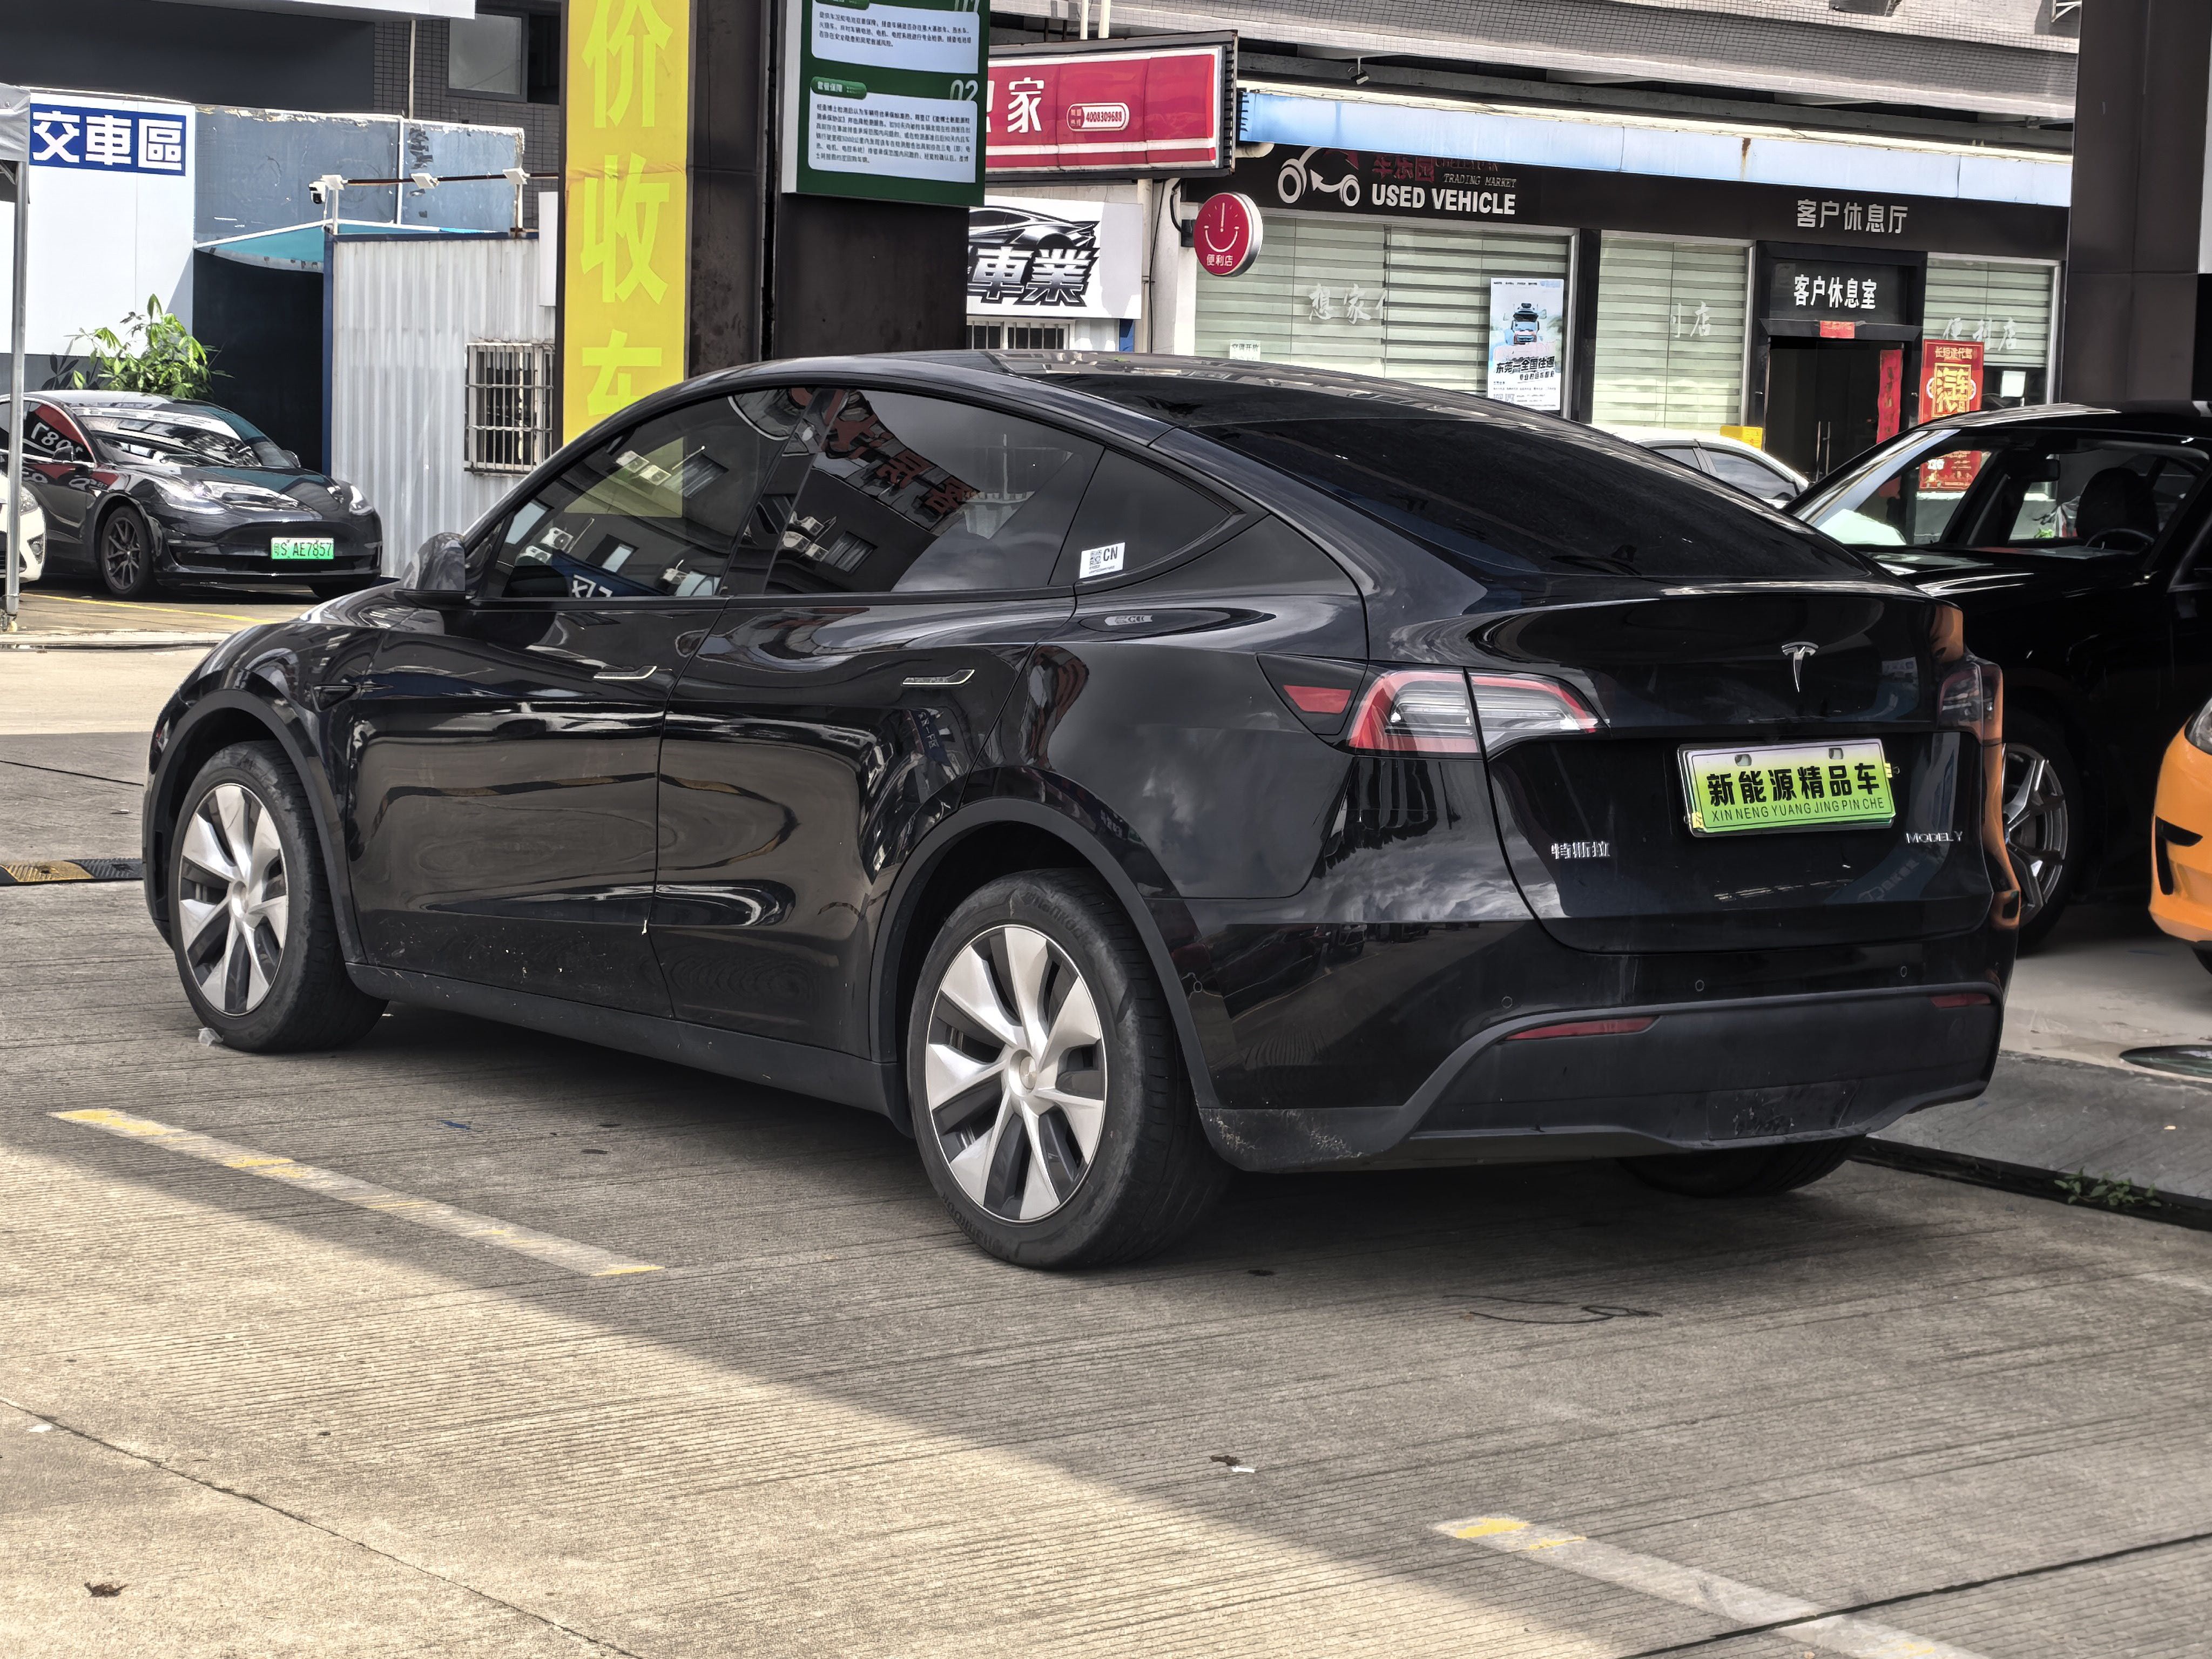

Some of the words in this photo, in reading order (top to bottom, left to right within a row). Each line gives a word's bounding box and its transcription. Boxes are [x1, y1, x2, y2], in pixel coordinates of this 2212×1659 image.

[986, 77, 1045, 133] 家
[1086, 111, 1122, 122] 4008309688
[32, 111, 183, 170] 交車區
[1444, 173, 1480, 185] TRADING
[1485, 176, 1517, 188] MARKET
[1372, 184, 1426, 208] USED
[1431, 188, 1516, 215] VEHICLE
[1797, 198, 1908, 234] 客户休息厅
[1206, 254, 1233, 266] 便利店
[968, 245, 1093, 304] 車業
[1794, 274, 1878, 311] 客户休息室
[1103, 545, 1118, 562] CN
[1707, 762, 1880, 806] 新能源精品车
[1711, 809, 1733, 822] XIN
[1736, 805, 1769, 820] NENG
[1771, 802, 1811, 817] YUANG
[1813, 800, 1839, 813] JING
[1841, 799, 1860, 812] PIN
[1862, 797, 1885, 810] CHE
[1550, 841, 1611, 860] 特斯拉
[1905, 832, 1954, 844] MODEL
[1954, 830, 1963, 842] Y
